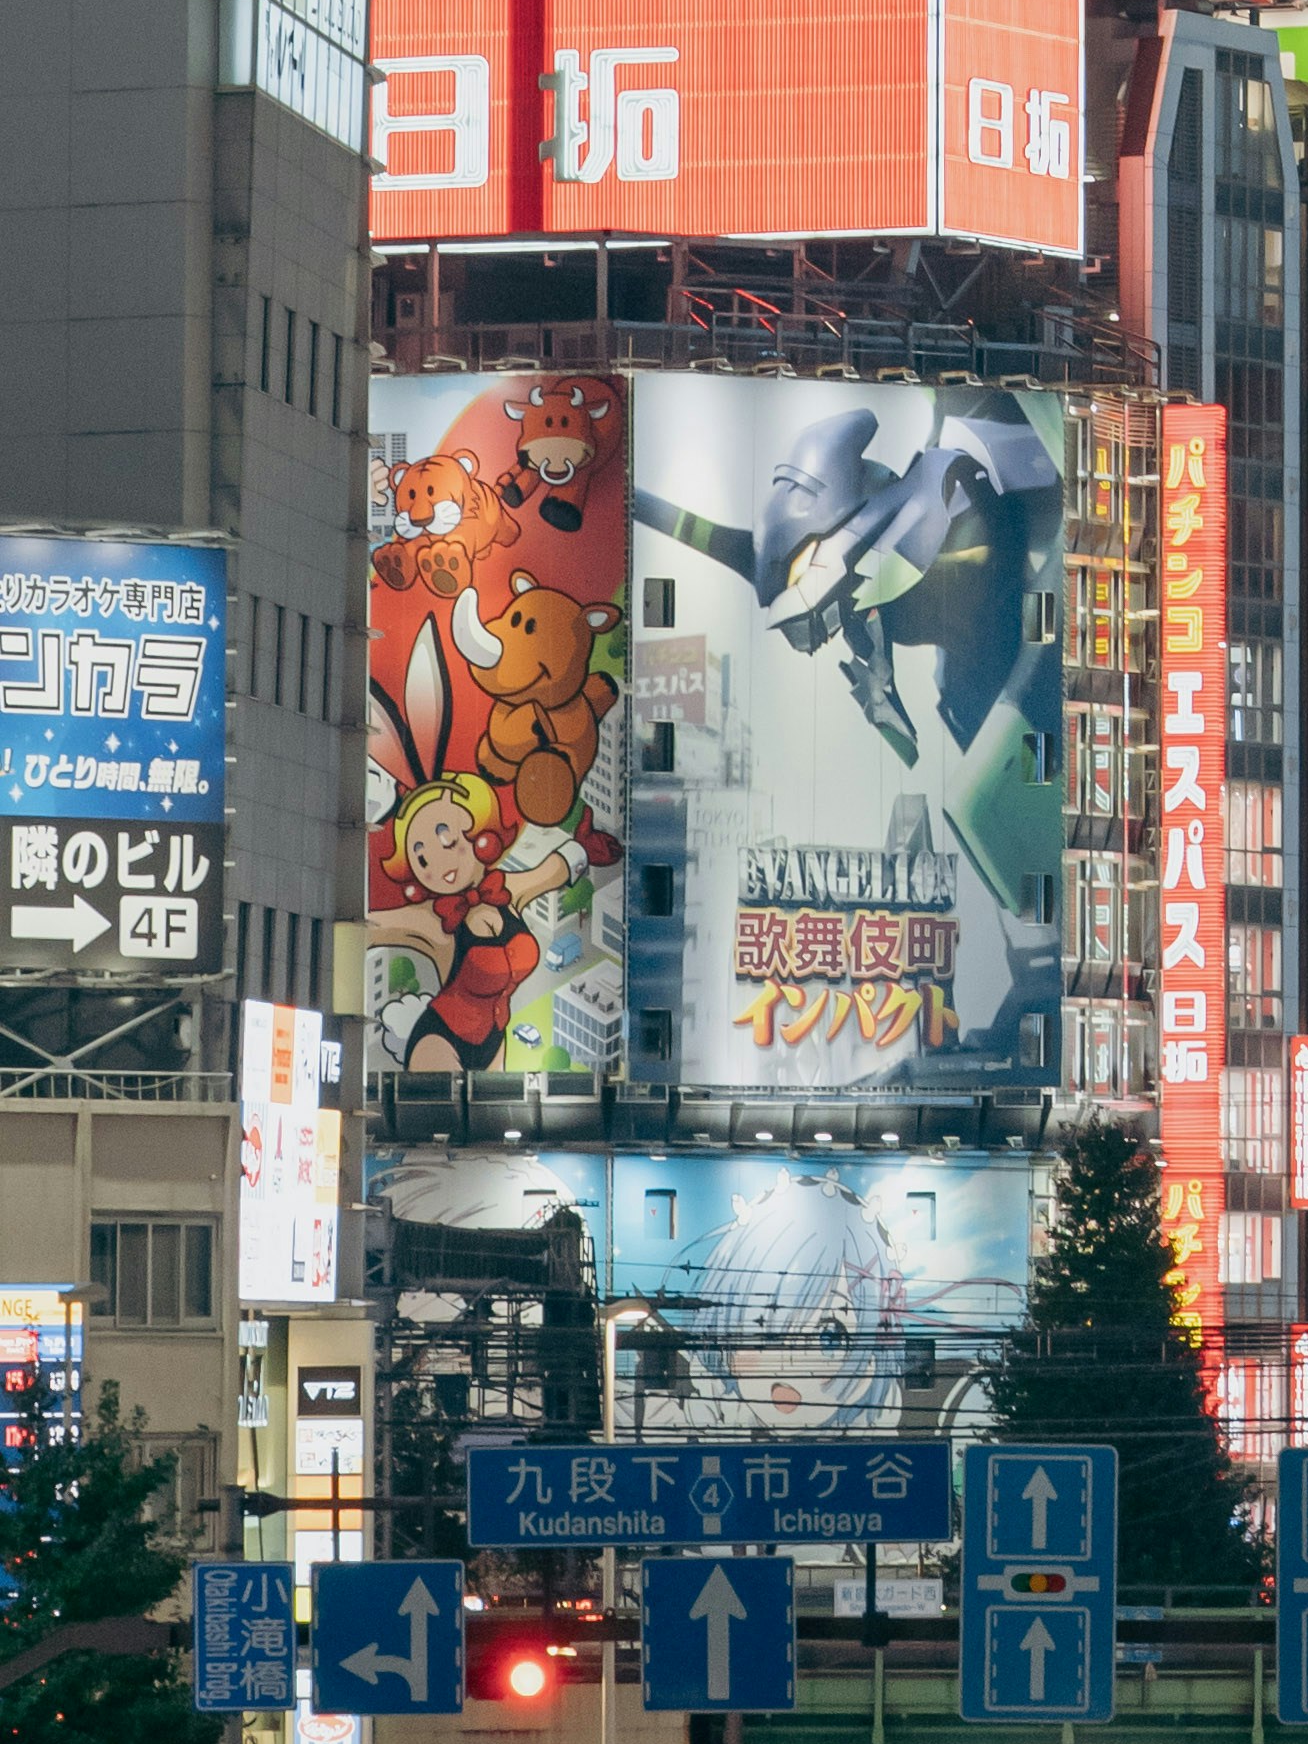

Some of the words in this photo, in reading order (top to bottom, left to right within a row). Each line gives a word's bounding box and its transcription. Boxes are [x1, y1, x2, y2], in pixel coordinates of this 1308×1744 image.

[371, 46, 680, 192] 日拓
[966, 77, 1071, 180] 日拓
[1166, 435, 1207, 653] パチンコ
[1163, 670, 1207, 970] エスパス
[10, 823, 211, 896] 隣のビル
[738, 847, 958, 906] EVANGELION
[128, 907, 190, 952] 4F
[735, 910, 960, 982] 歌舞伎町
[733, 977, 960, 1049] インパクト
[1162, 989, 1209, 1083] 日拓
[505, 1455, 678, 1506] 九段下
[700, 1484, 721, 1507] 4
[518, 1511, 665, 1537] Kudanshita
[773, 1508, 884, 1537] Ichigaya
[238, 1573, 289, 1702] 小滝橋
[199, 1662, 222, 1706] Brdg.
